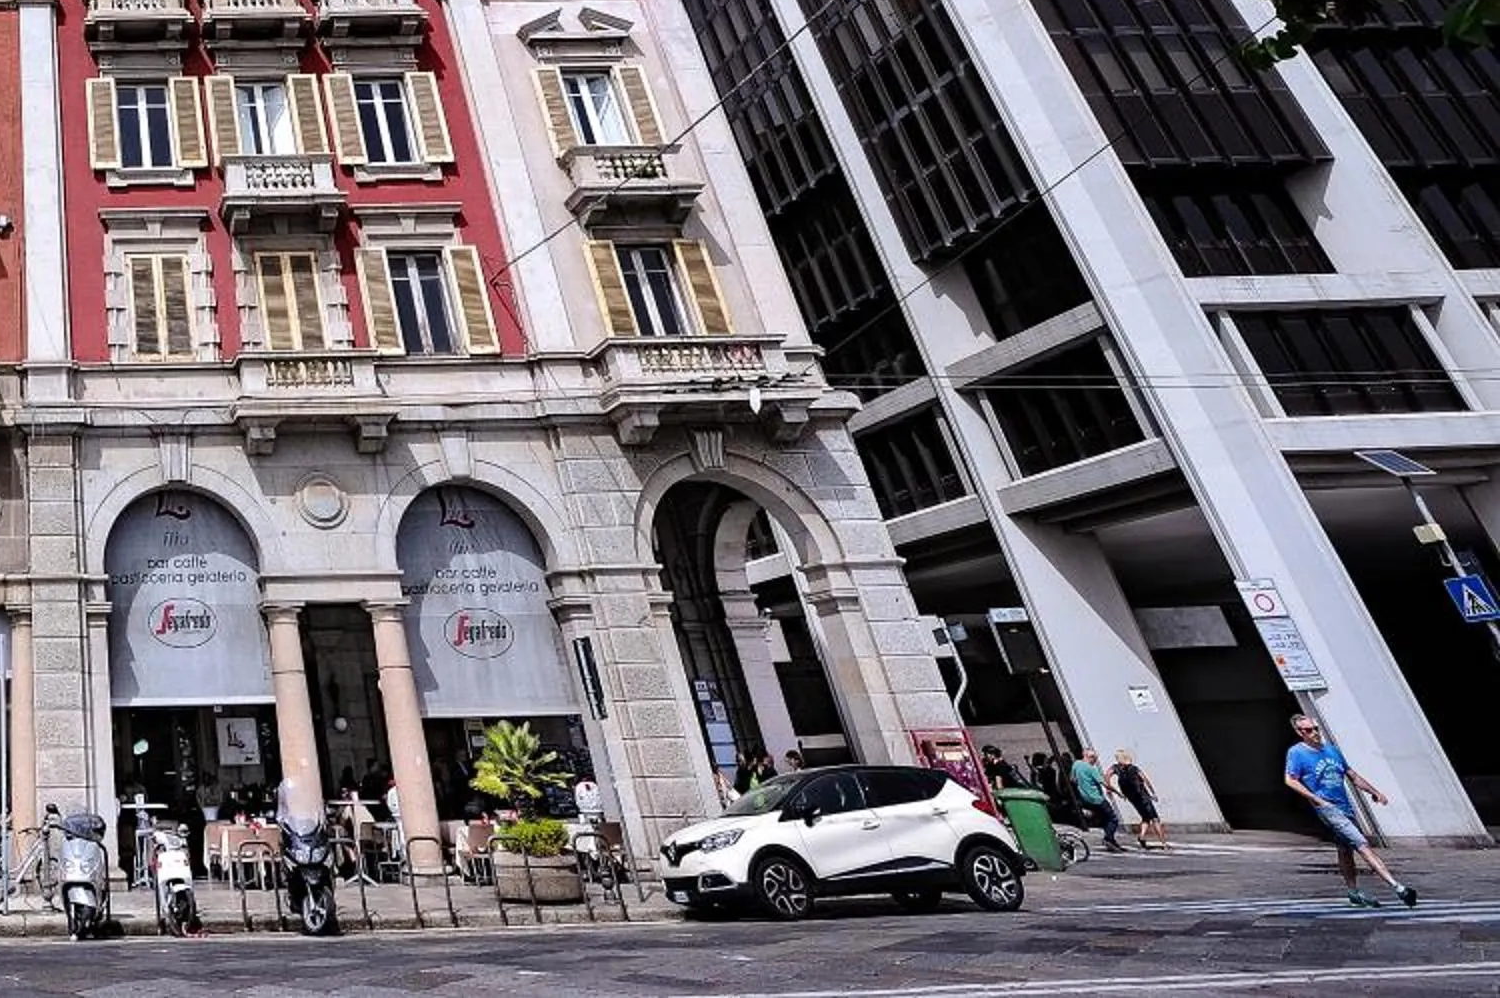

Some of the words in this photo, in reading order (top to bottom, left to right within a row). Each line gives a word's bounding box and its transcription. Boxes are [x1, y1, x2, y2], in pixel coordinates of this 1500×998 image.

[147, 557, 169, 569] bar
[110, 571, 183, 585] pasticceria
[187, 569, 247, 586] gelateria
[479, 580, 539, 596] gelateria
